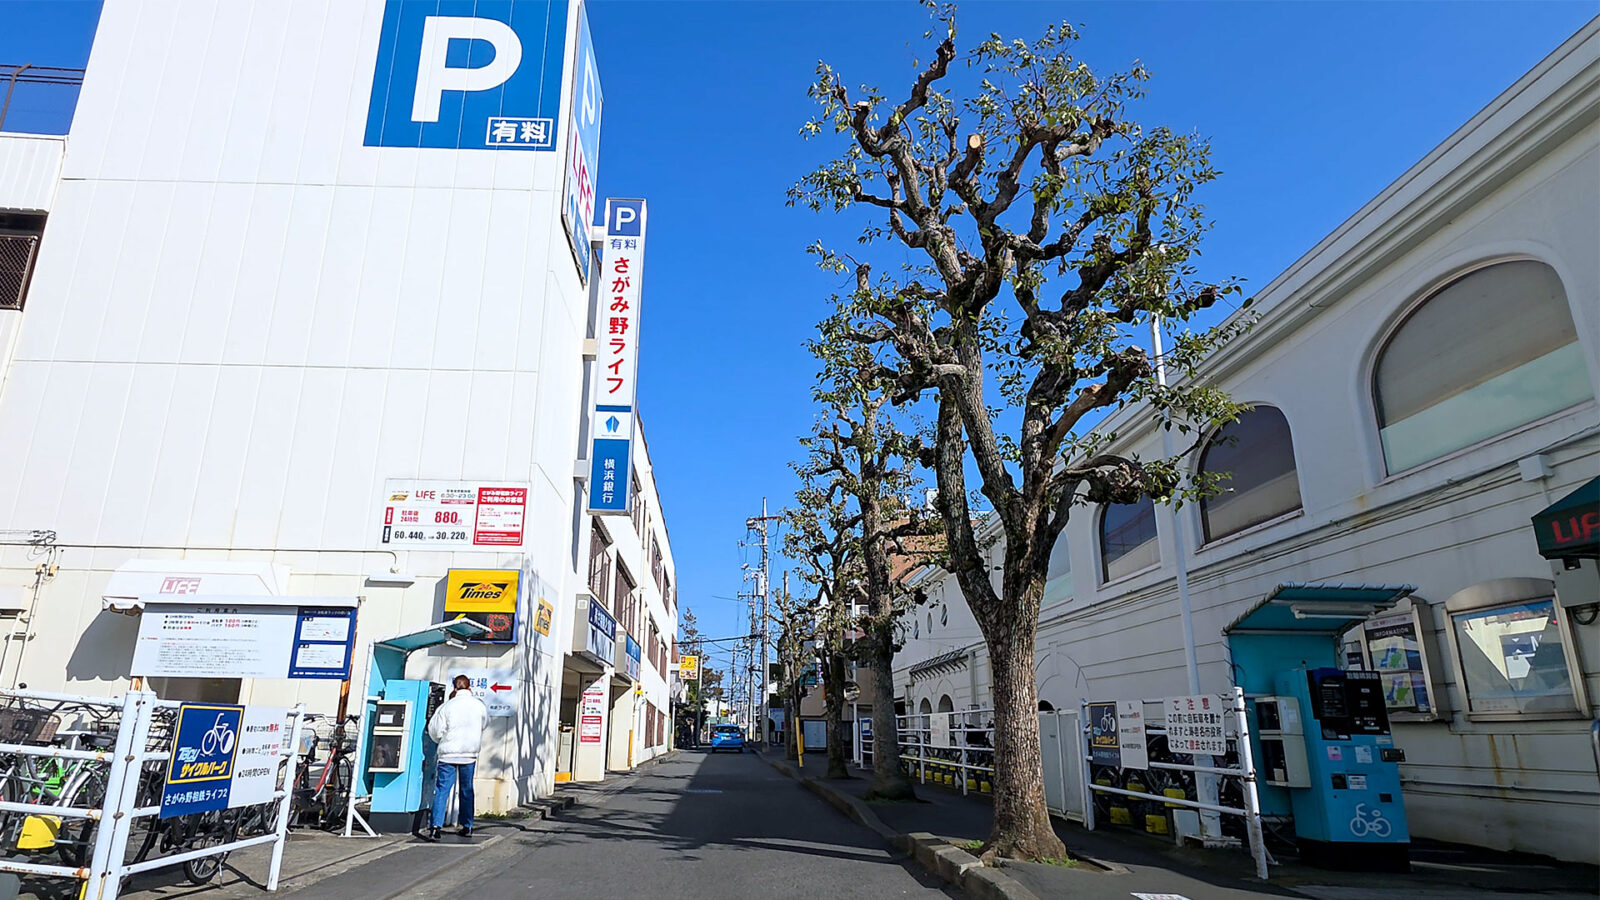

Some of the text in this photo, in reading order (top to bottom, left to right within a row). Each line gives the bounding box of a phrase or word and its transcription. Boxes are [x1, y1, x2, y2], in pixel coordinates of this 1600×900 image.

[411, 16, 523, 122] P
[491, 120, 547, 143] 有料
[573, 131, 592, 235] LIFE
[615, 206, 636, 231] P
[610, 238, 637, 250] 有料
[606, 256, 631, 395] さがみ野ライフ
[602, 458, 616, 504] 横浜銀行
[415, 490, 436, 500] LIFE
[460, 586, 502, 599] Times
[1173, 697, 1210, 711] ご注意
[180, 761, 228, 779] サイクルパーク
